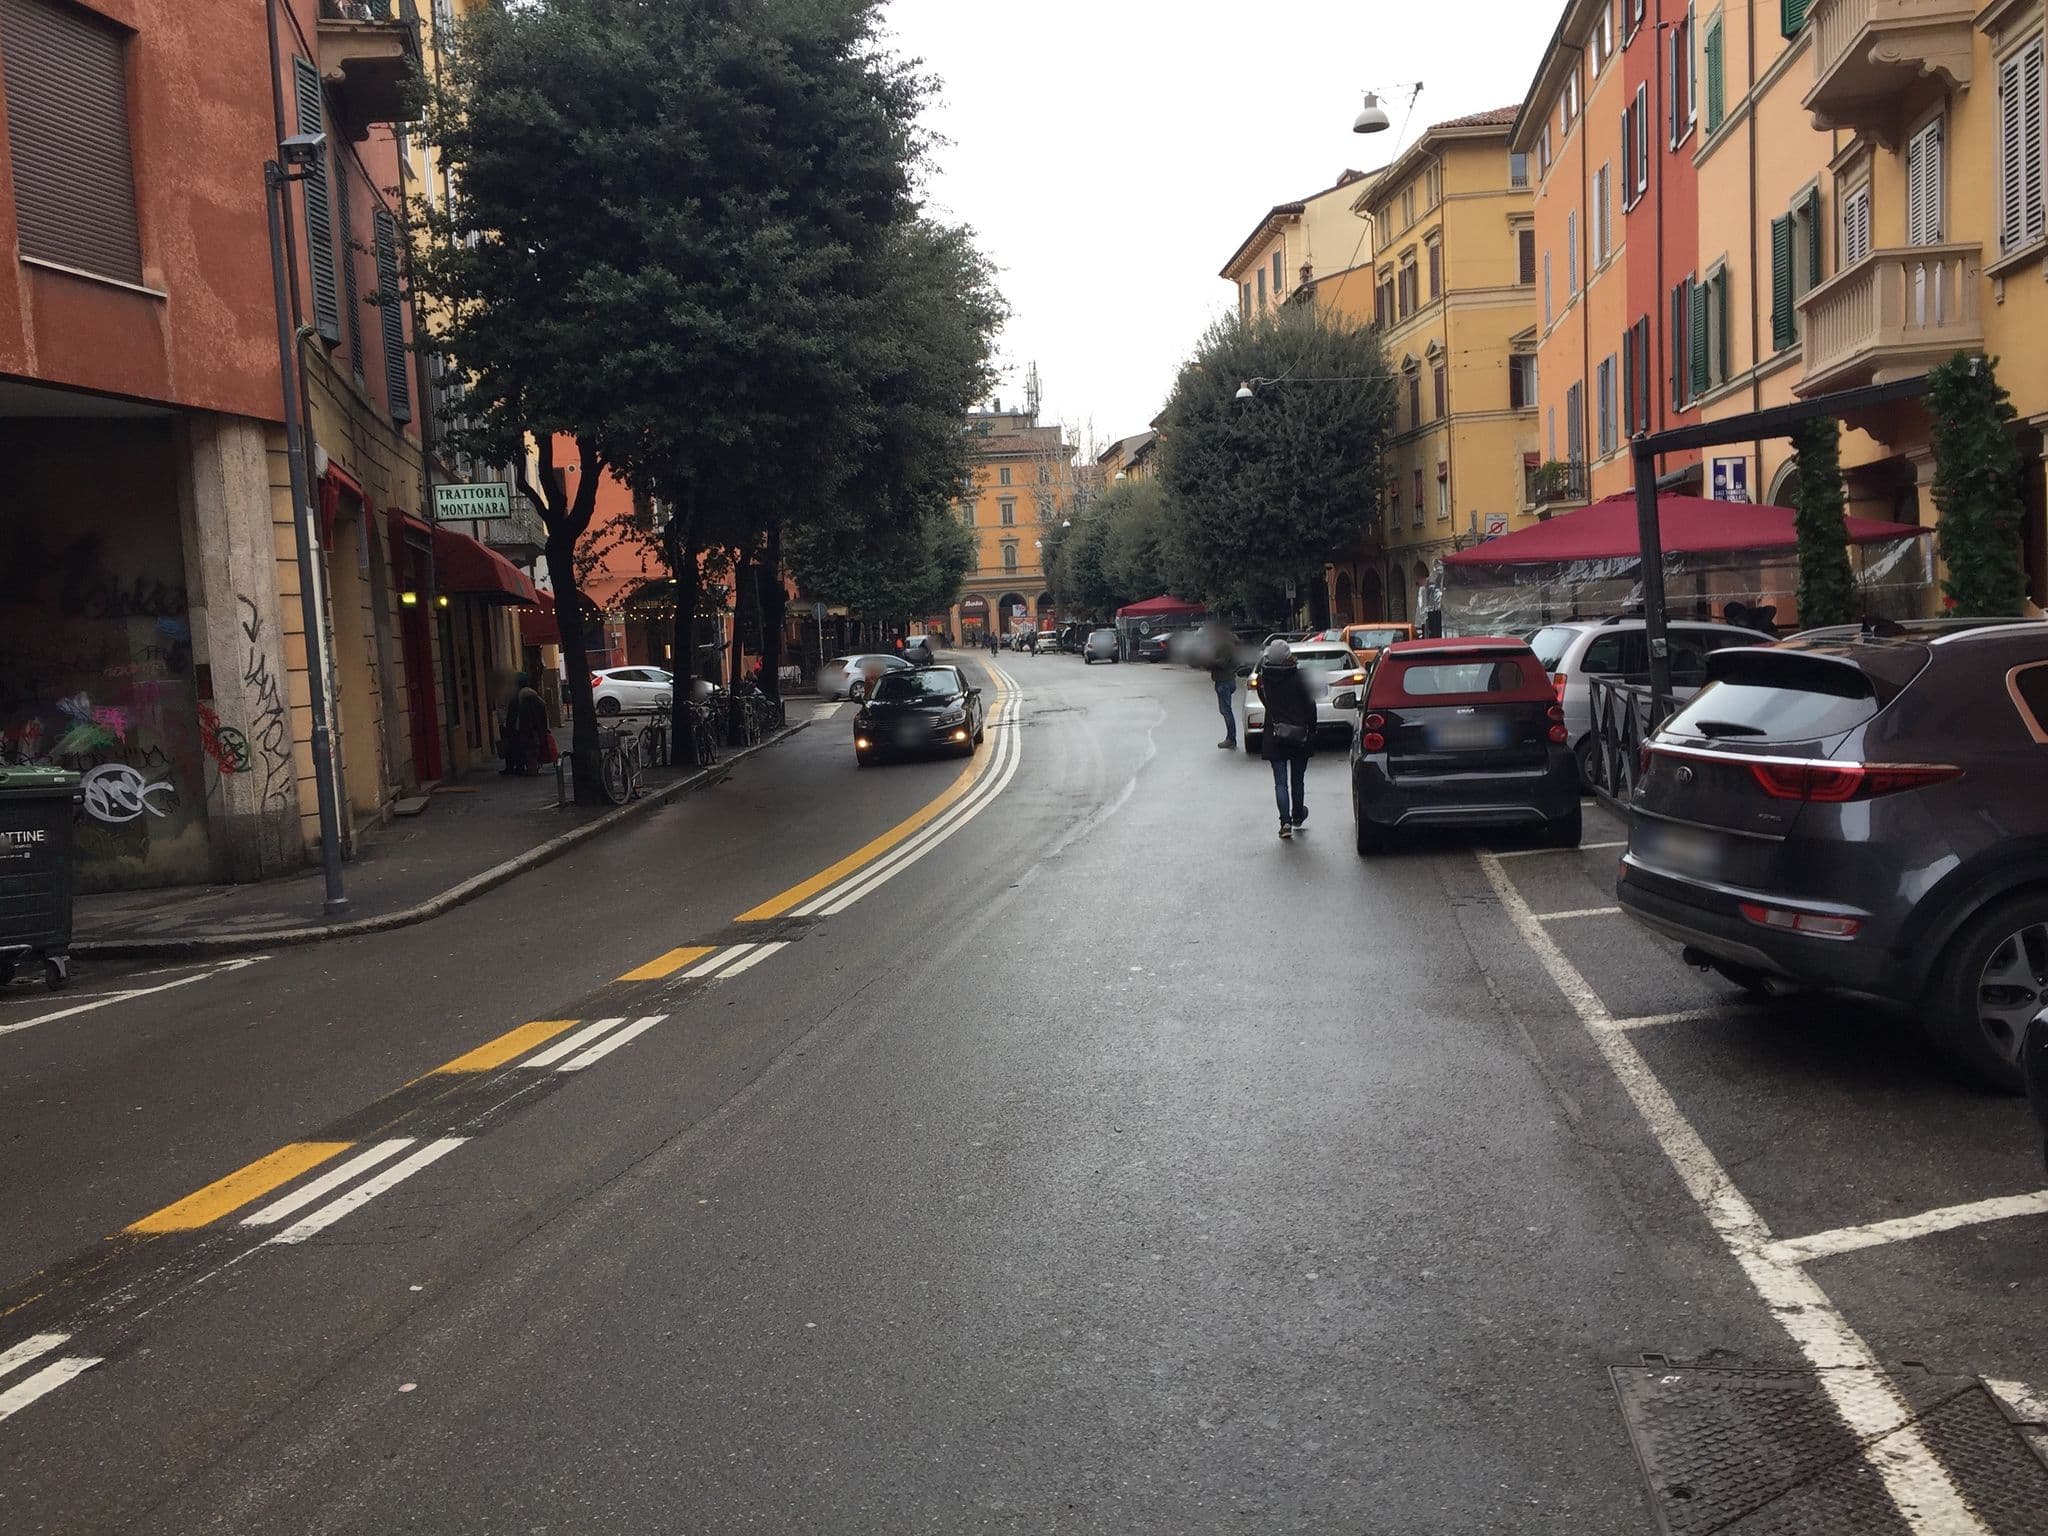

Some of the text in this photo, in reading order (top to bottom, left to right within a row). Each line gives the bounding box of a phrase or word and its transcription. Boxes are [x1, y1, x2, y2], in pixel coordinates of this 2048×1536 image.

[1716, 458, 1744, 489] T
[437, 487, 506, 500] TRATTORIA
[440, 502, 506, 517] MONTANARA
